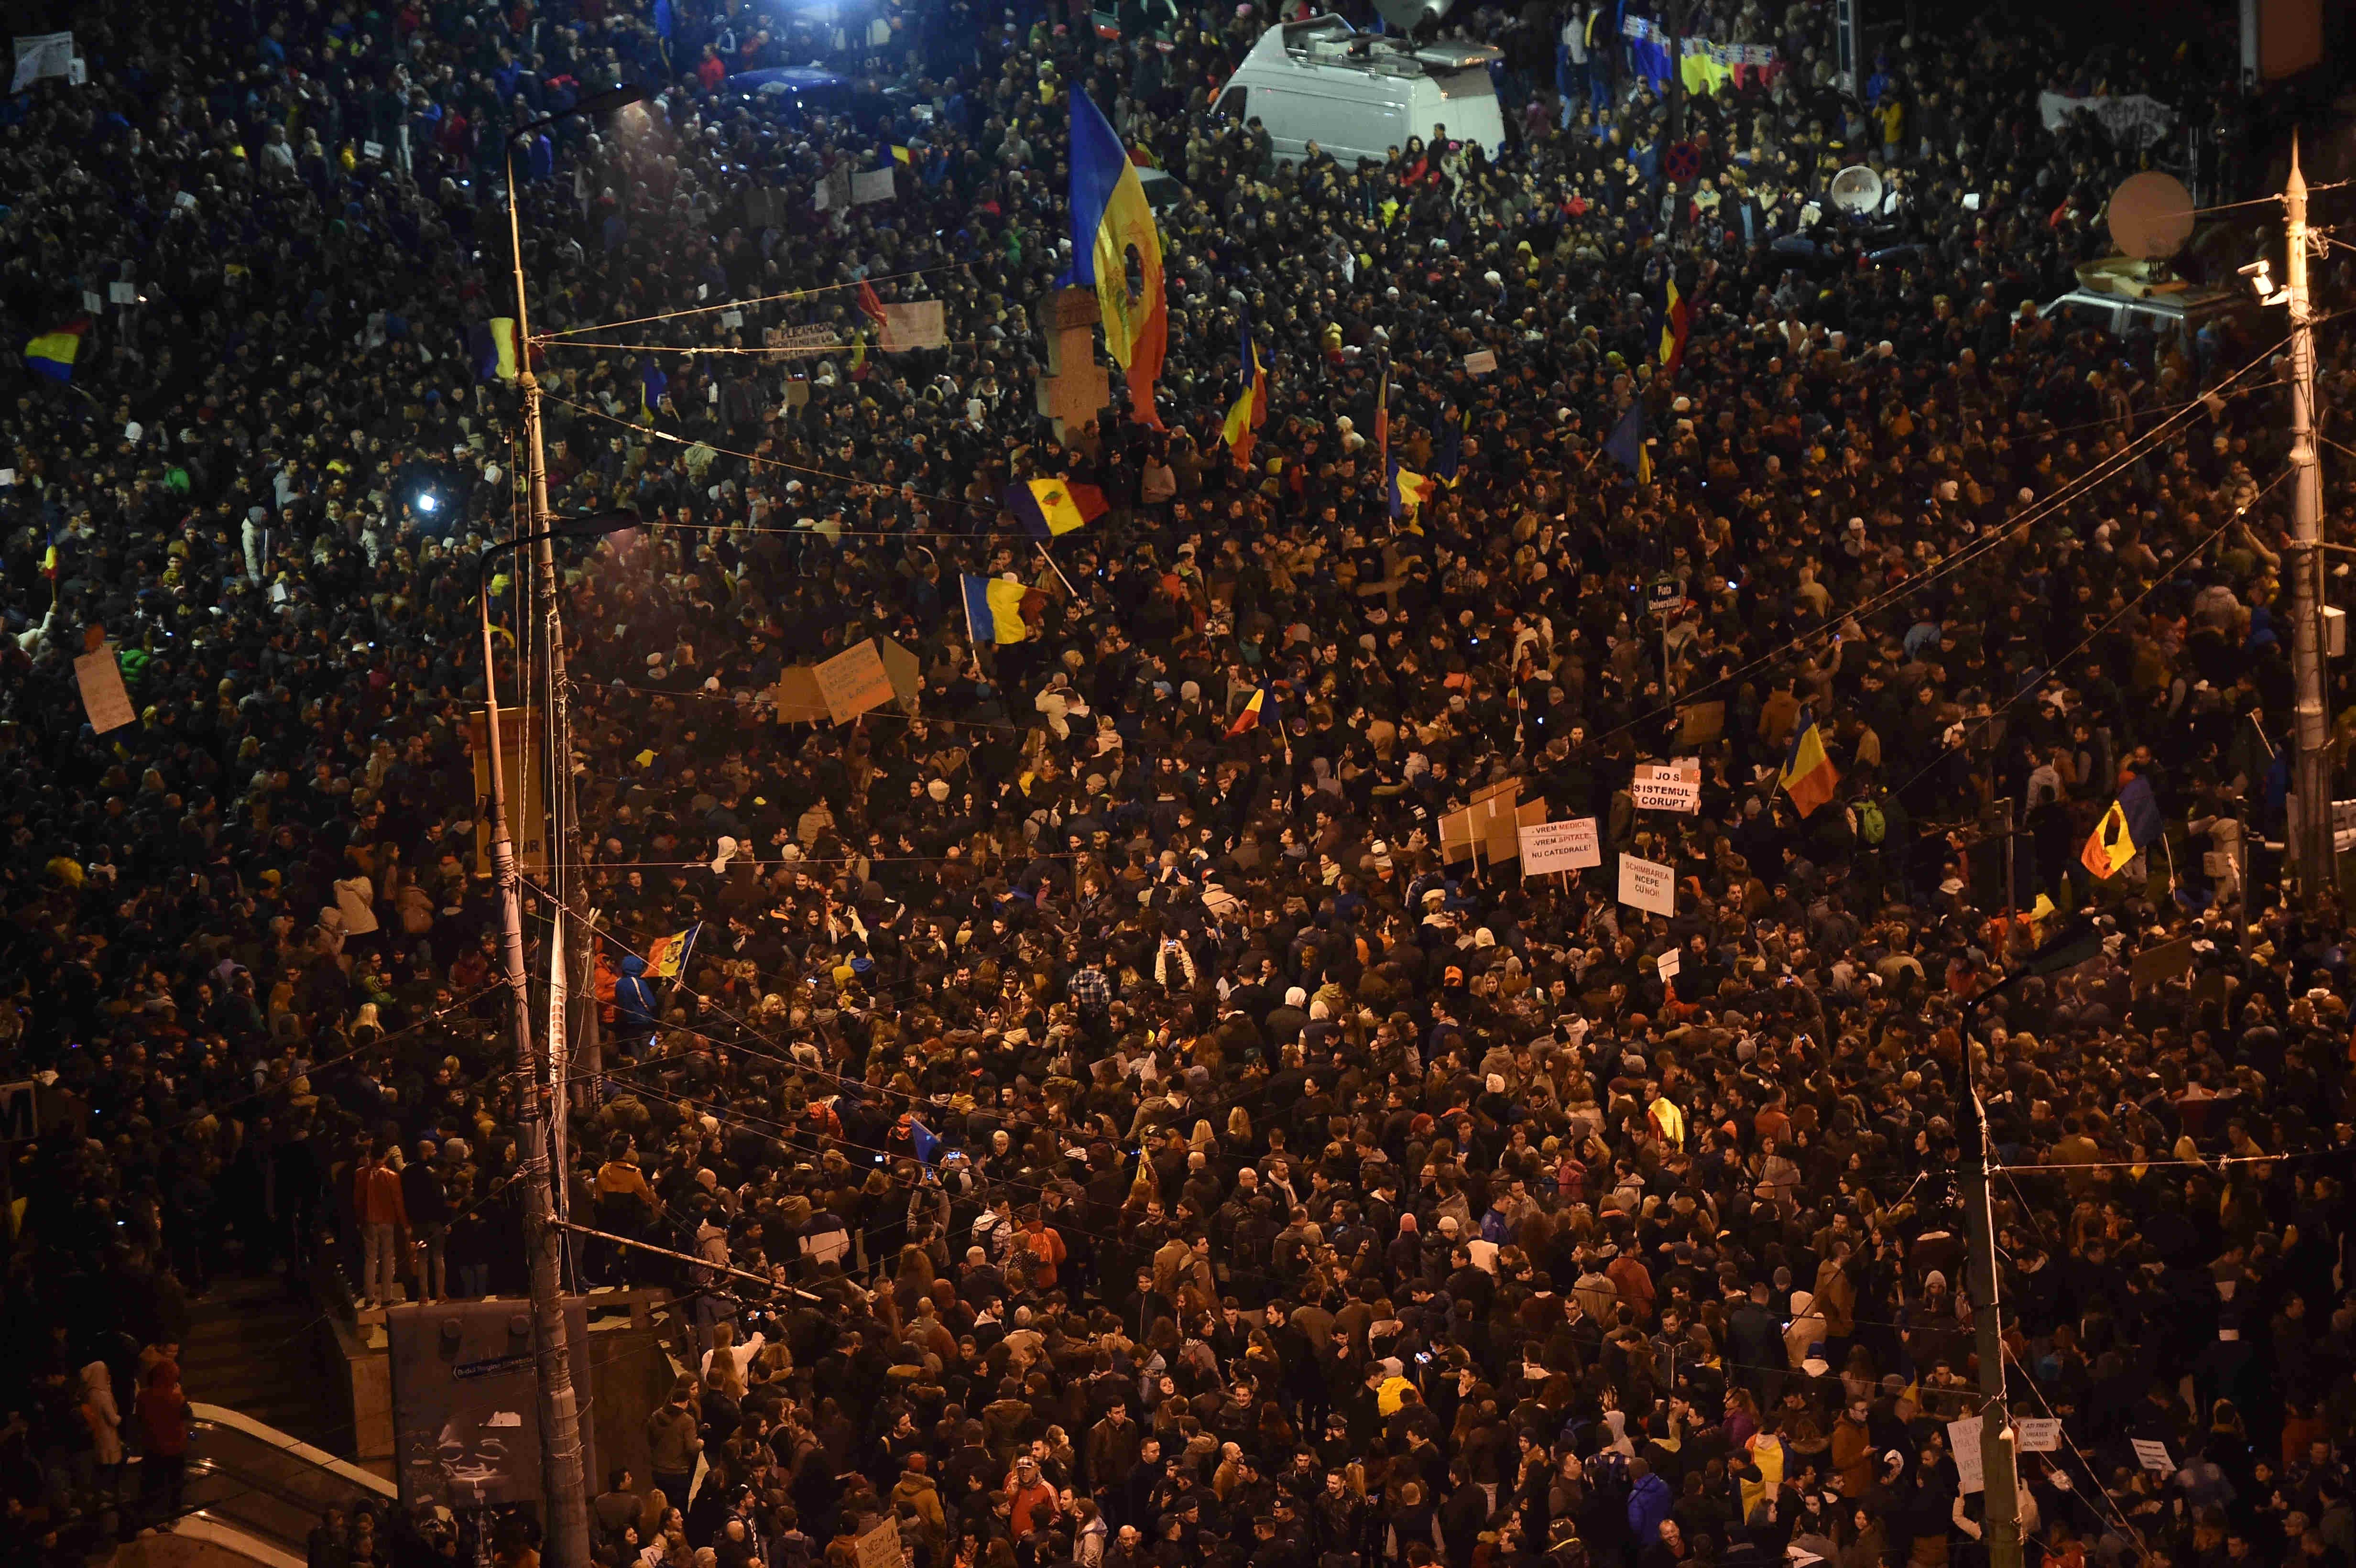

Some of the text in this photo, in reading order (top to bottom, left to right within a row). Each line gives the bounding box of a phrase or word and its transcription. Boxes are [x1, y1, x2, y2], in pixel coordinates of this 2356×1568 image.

[1642, 796, 1686, 807] CORUPT
[1536, 825, 1557, 834] VREM
[1544, 844, 1591, 857] CATEDRALE!
[1625, 861, 1669, 880] SCHIMBAREA
[1635, 874, 1659, 887] INCEPE
